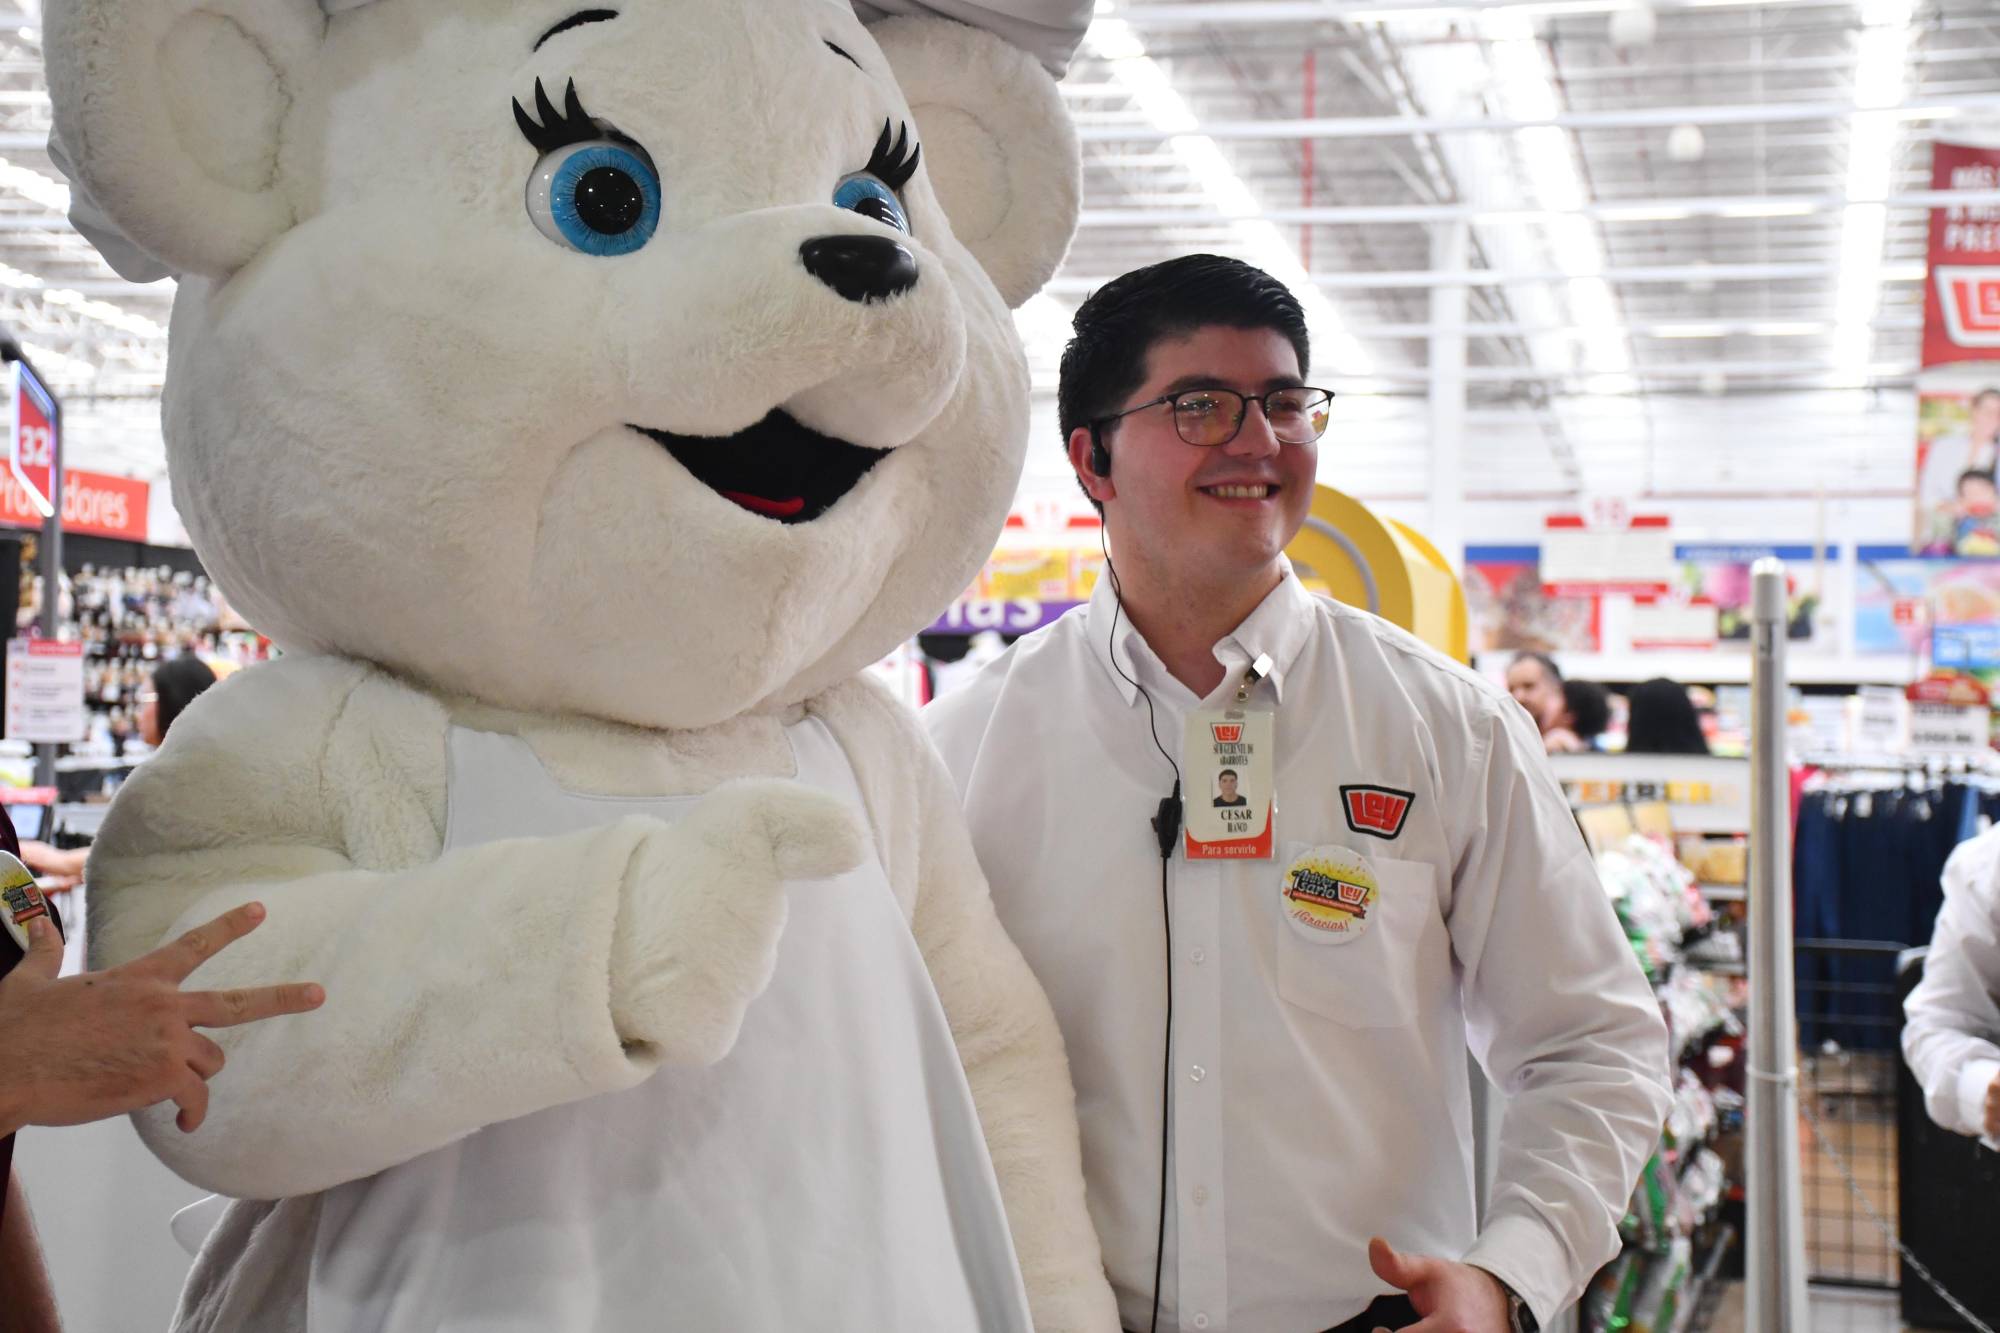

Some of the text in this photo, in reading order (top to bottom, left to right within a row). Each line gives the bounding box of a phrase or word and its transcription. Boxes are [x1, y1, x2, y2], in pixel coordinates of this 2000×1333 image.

[20, 425, 50, 466] 32
[1221, 809, 1252, 820] CESAR
[1202, 844, 1221, 855] Para
